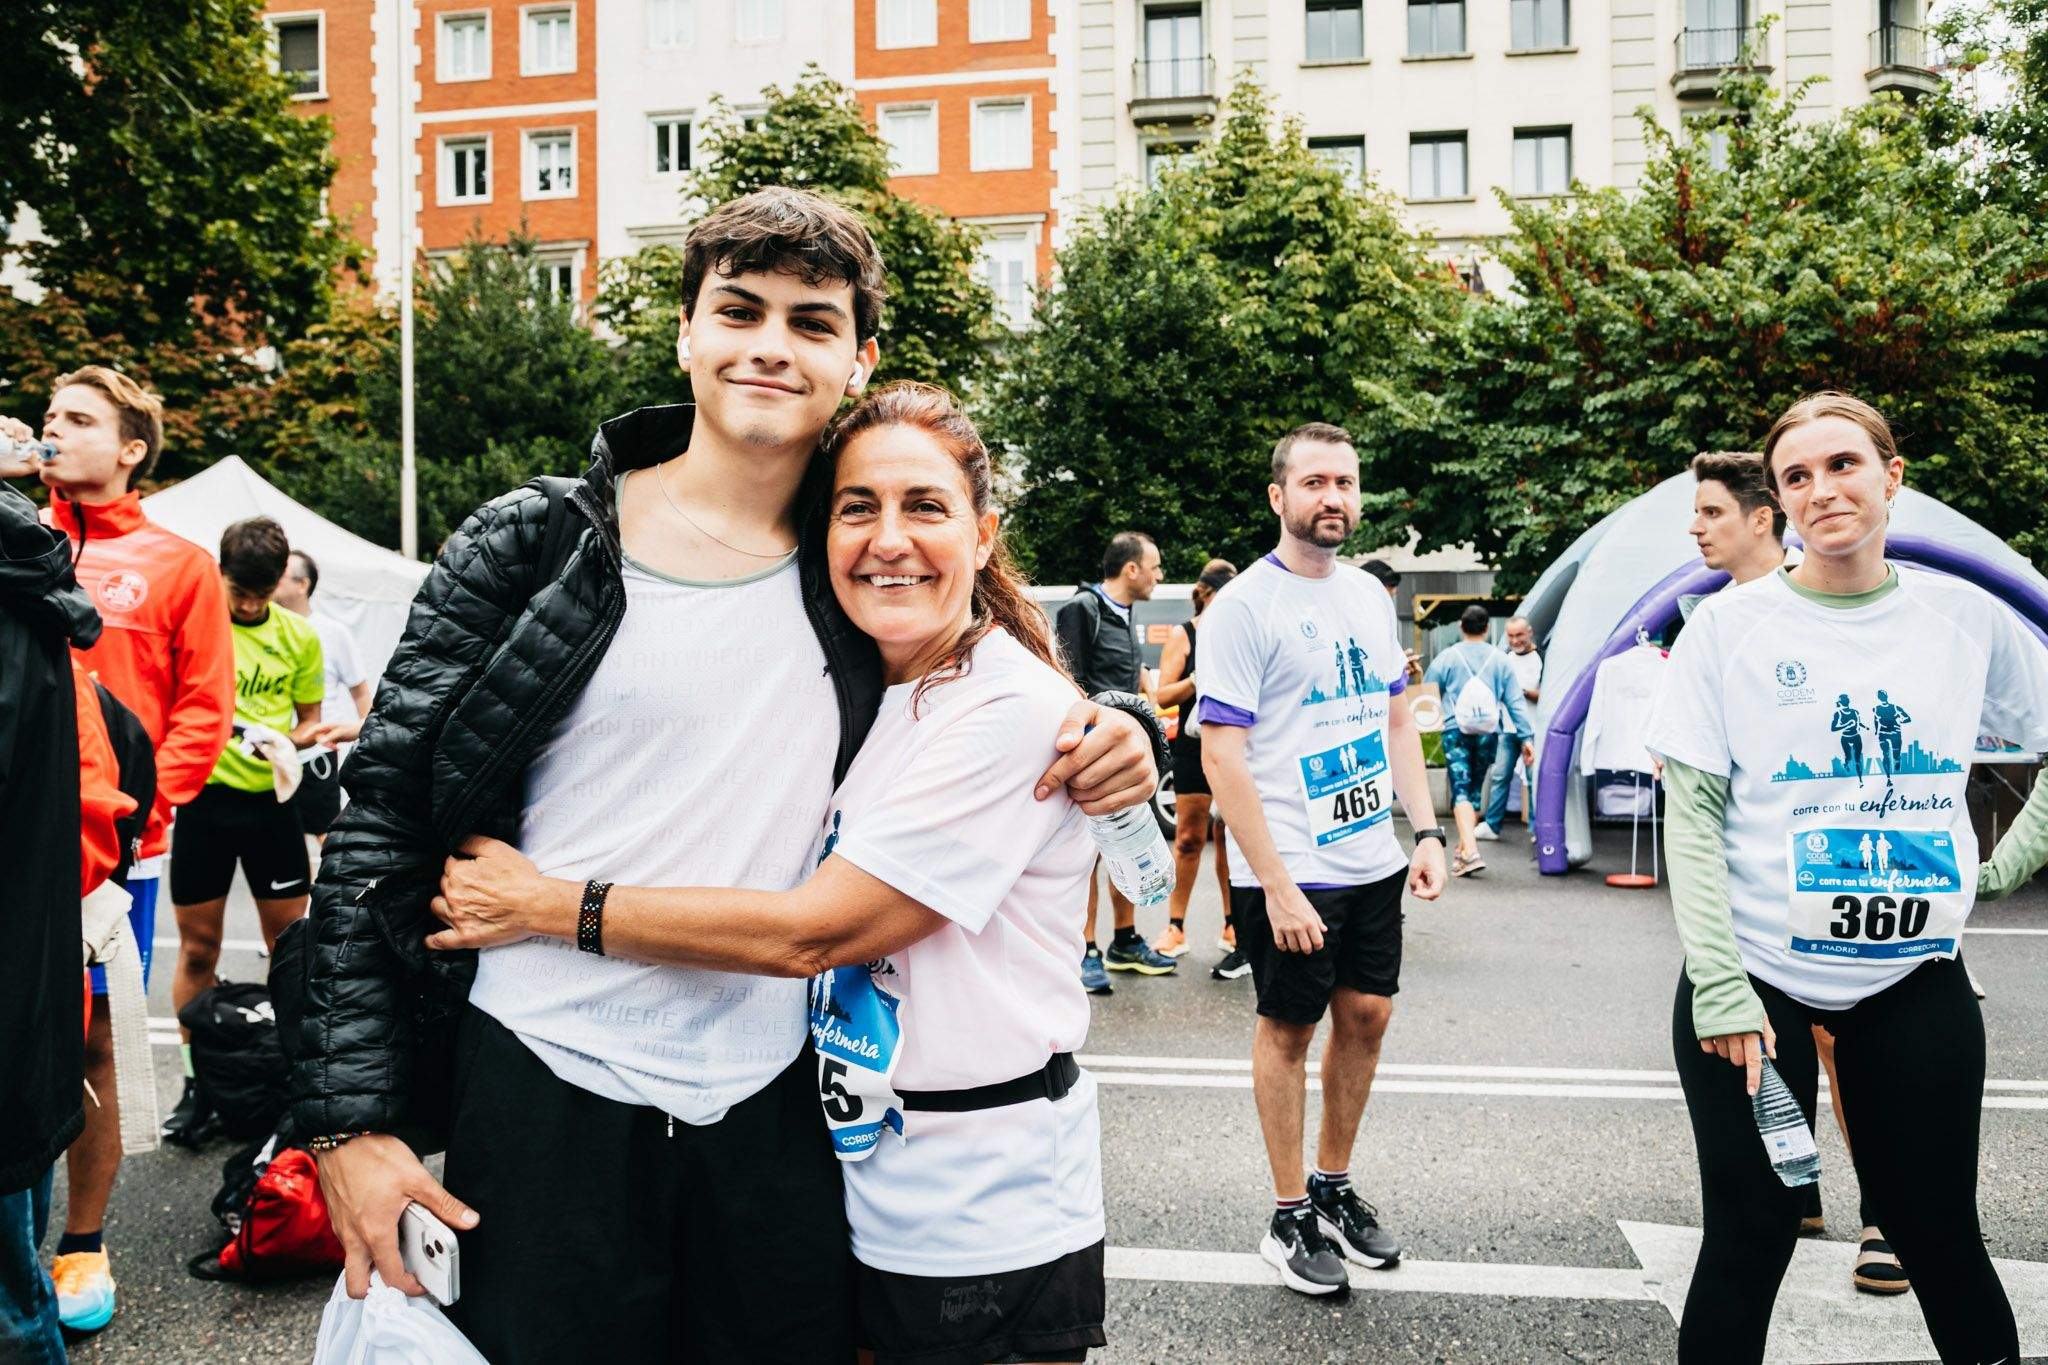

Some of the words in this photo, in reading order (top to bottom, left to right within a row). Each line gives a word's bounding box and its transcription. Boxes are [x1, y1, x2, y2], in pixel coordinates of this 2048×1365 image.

[1334, 780, 1380, 823] 465
[1793, 805, 1819, 816] corre
[1822, 804, 1840, 813] con
[1845, 803, 1855, 812] tu
[1819, 878, 1841, 886] corre
[1843, 879, 1858, 887] con
[1858, 877, 1869, 887] tu
[1870, 868, 1952, 893] enfermera
[1830, 895, 1930, 940] 360
[1821, 944, 1858, 954] MADRID
[821, 1057, 863, 1122] 5
